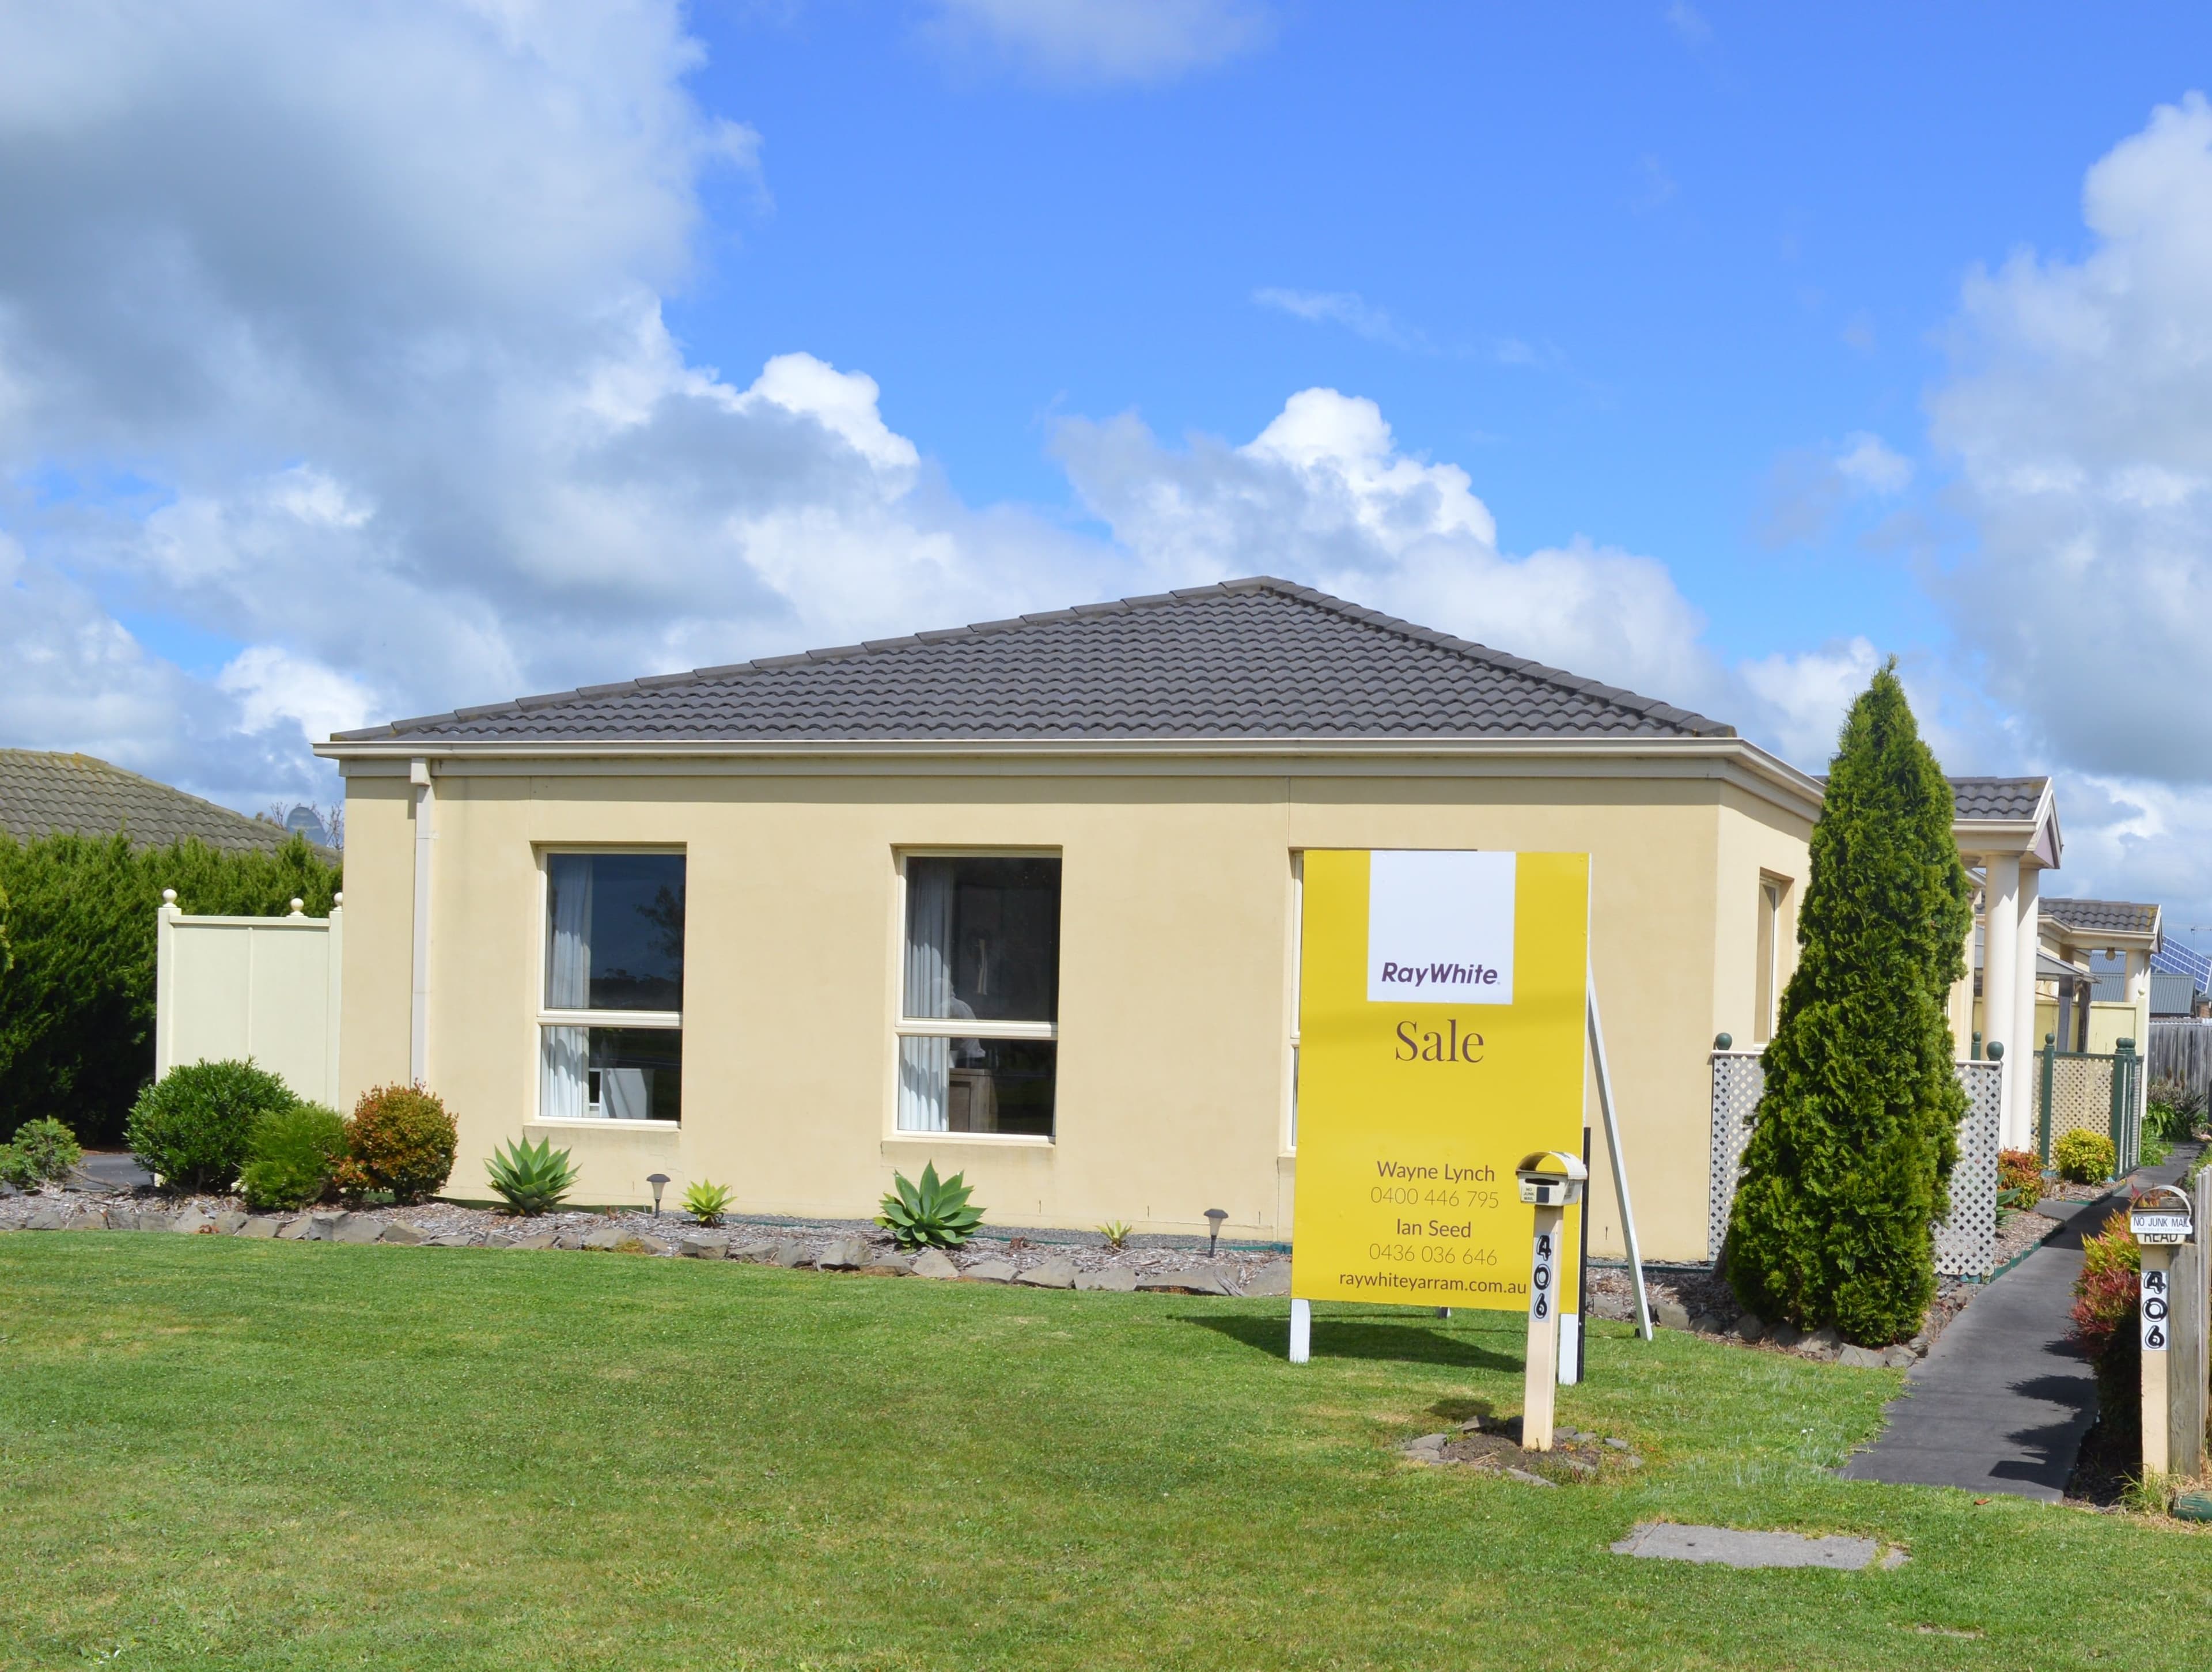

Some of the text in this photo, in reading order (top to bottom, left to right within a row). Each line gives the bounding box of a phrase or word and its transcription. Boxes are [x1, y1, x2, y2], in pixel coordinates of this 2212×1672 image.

[1395, 1019, 1484, 1064] Sale
[1377, 1160, 1495, 1184] Wayne Lynch
[1370, 1186, 1499, 1208] 0400 446 795
[1396, 1218, 1472, 1238] Ian Seed
[2133, 1217, 2190, 1228] NO JUNK MAIL
[1369, 1243, 1498, 1266] 0436 036 646
[1339, 1272, 1527, 1294] raywhiteyarram.com.au
[1533, 1235, 1551, 1319] 406
[2142, 1271, 2168, 1349] 406
